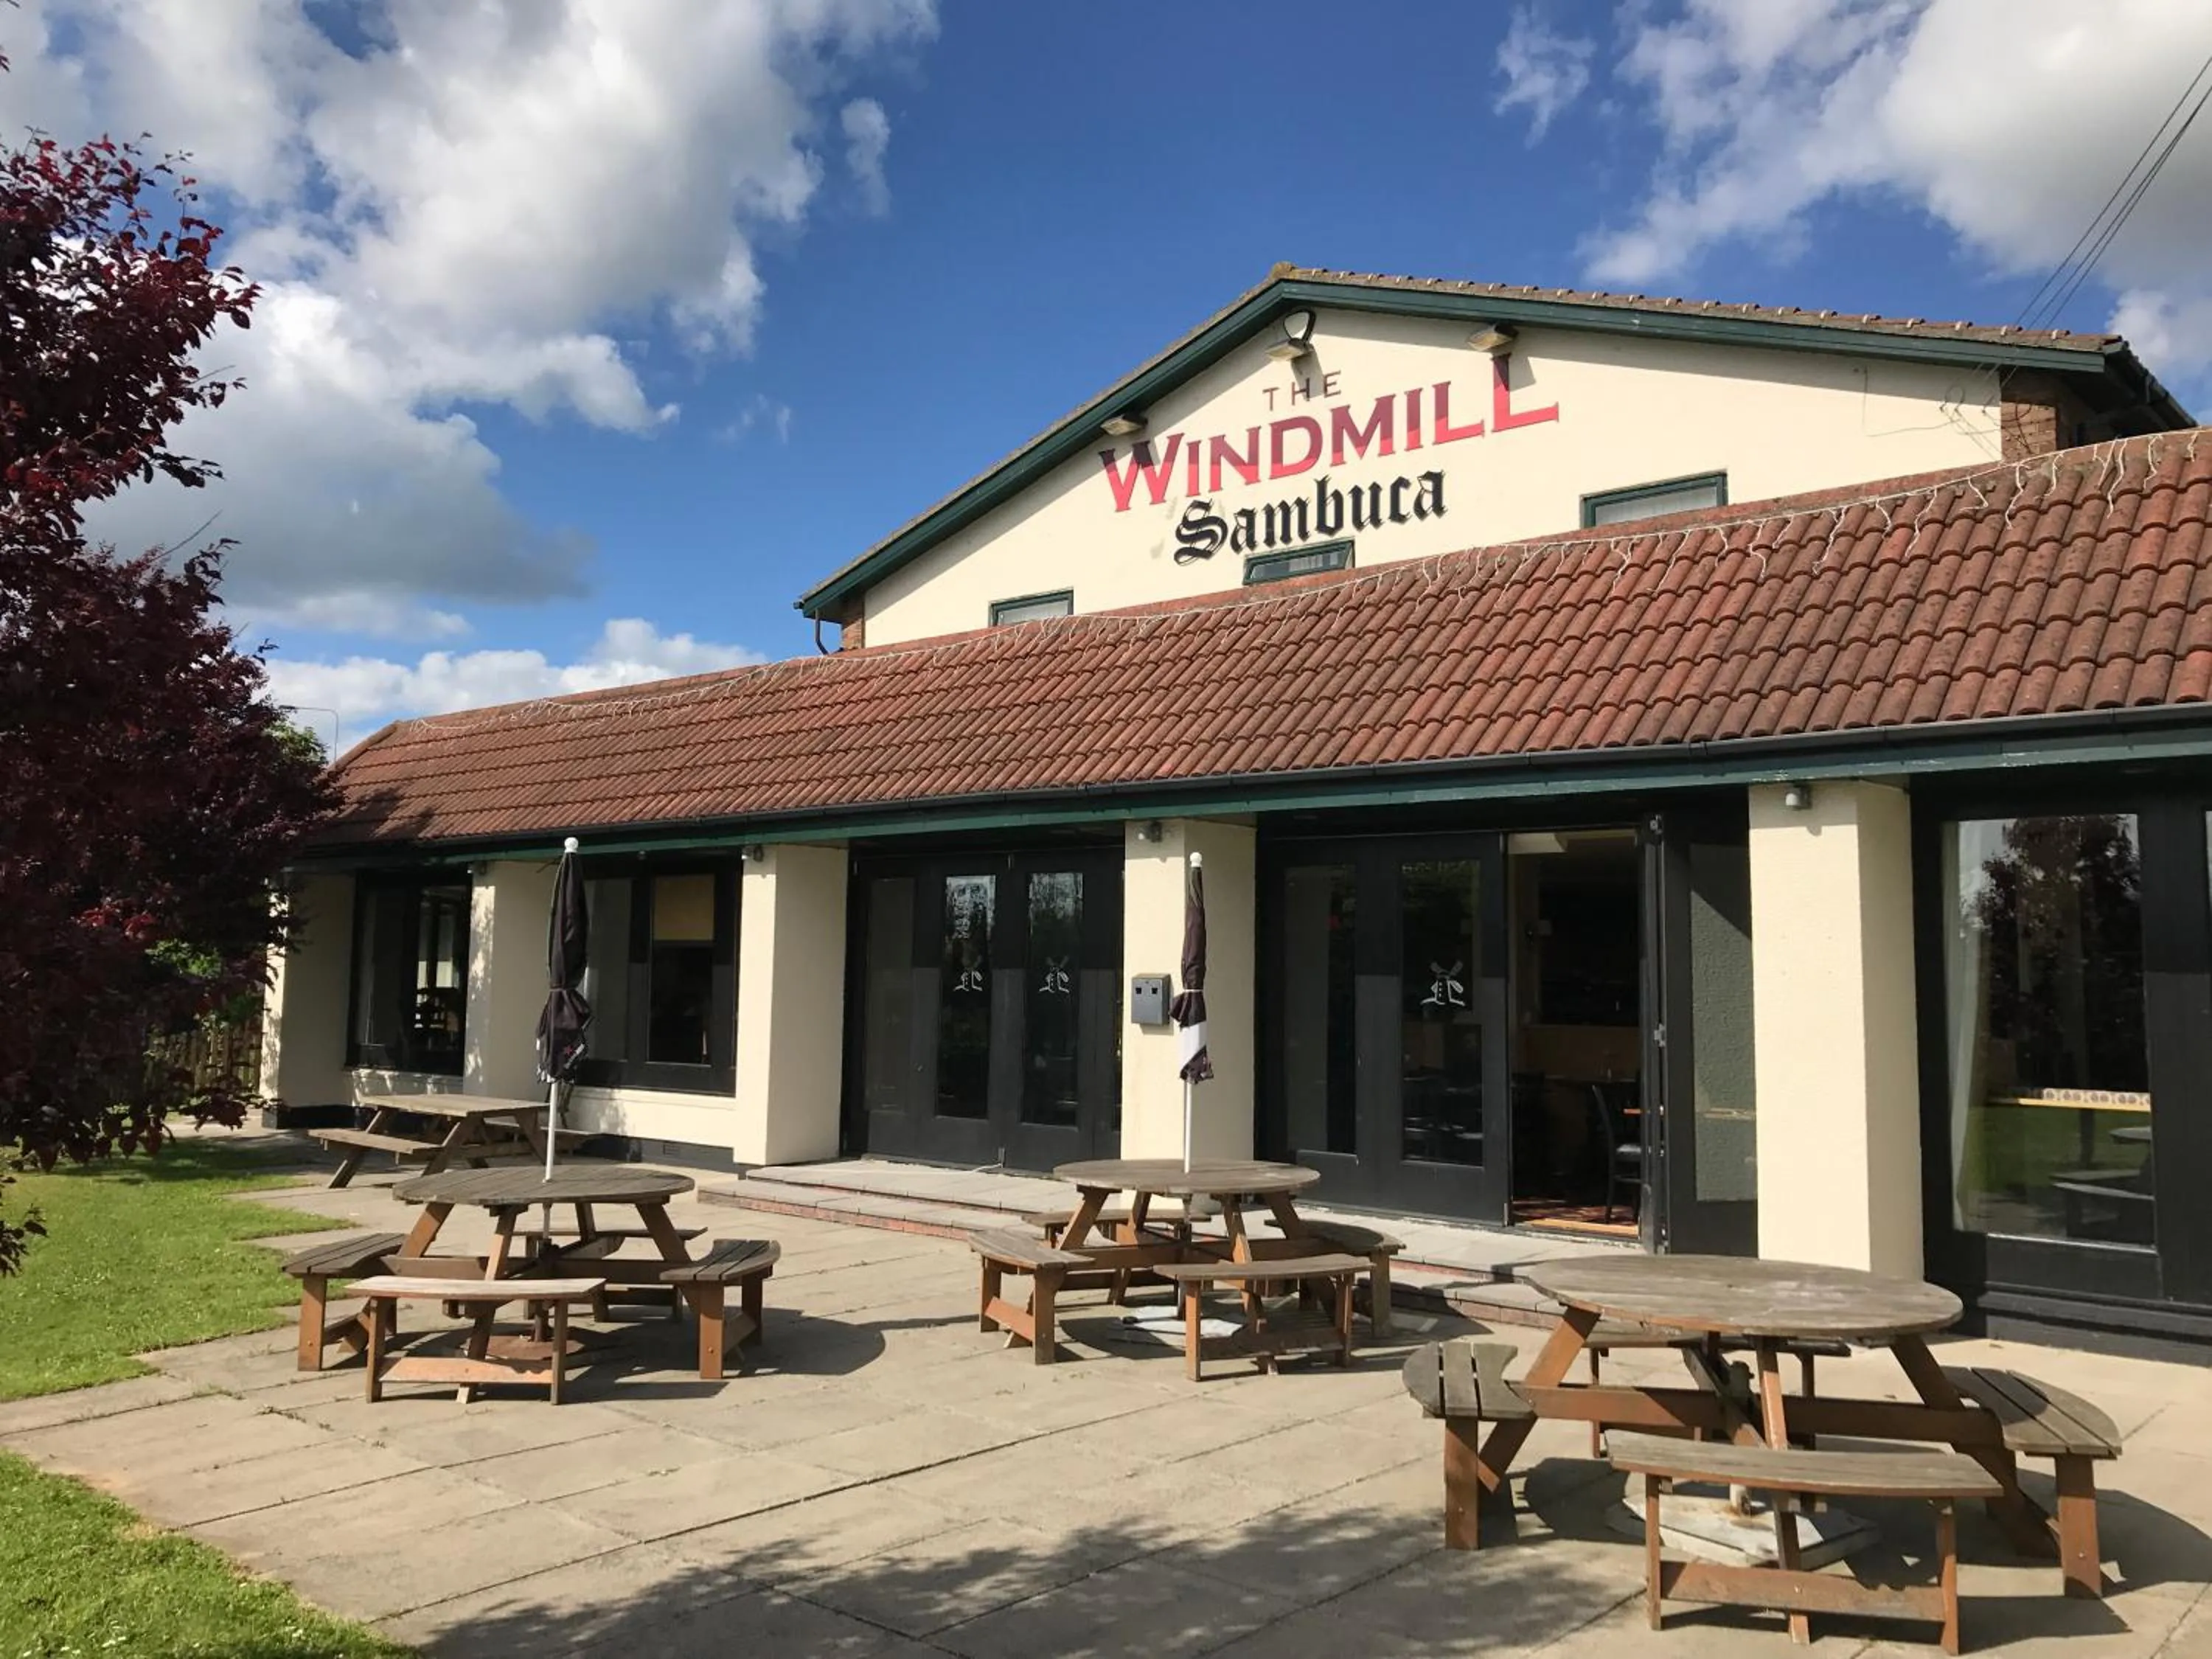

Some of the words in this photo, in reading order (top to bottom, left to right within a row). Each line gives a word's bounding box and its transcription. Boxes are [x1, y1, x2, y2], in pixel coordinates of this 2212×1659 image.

[1099, 352, 1559, 512] WINDMILL
[1262, 370, 1341, 411] THE
[1174, 470, 1446, 566] Sambuca
